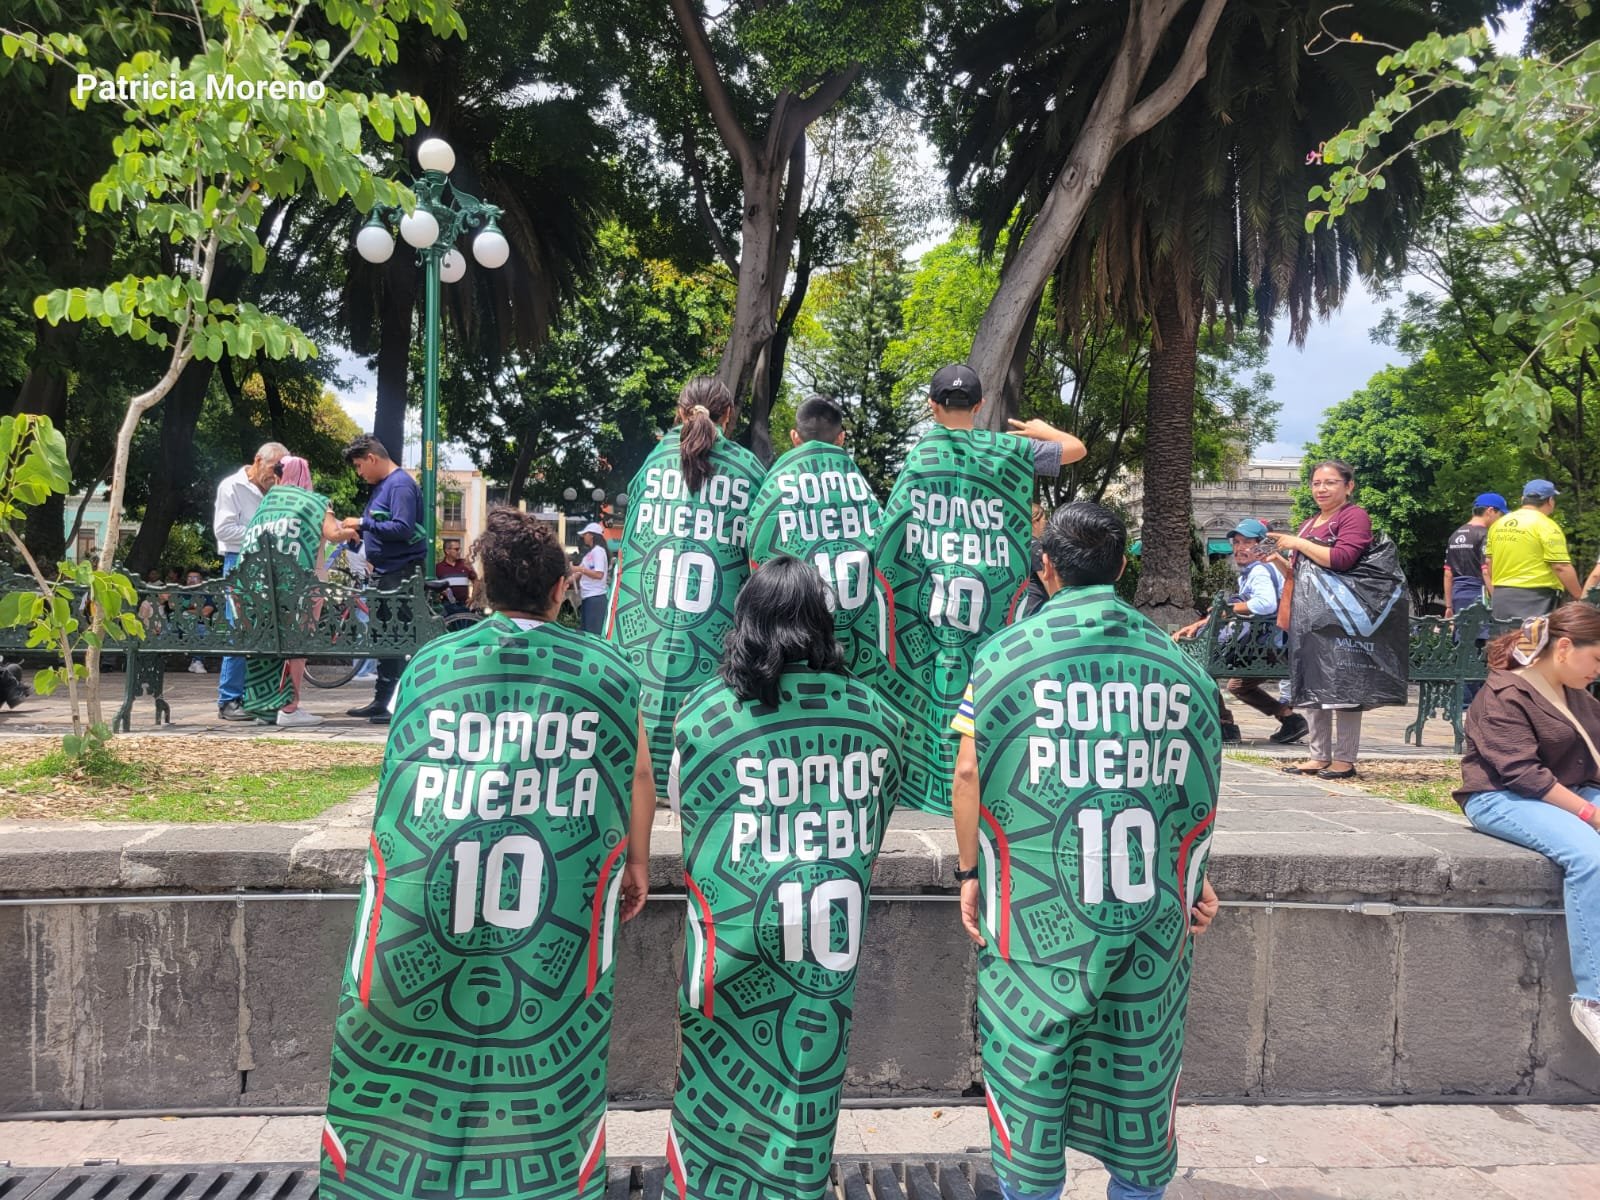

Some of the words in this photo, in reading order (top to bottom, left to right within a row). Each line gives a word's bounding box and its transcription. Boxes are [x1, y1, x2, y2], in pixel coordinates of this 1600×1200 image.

[636, 503, 748, 548] PUEBLA
[778, 505, 885, 542] PUEBL
[910, 489, 1004, 530] SOMOS
[906, 523, 1010, 567] PUEBLA
[655, 548, 715, 613] 10
[814, 551, 870, 613] 10
[929, 573, 985, 634] 10
[1033, 680, 1191, 732] SOMOS
[428, 709, 599, 763] SOMOS
[1028, 735, 1191, 789] PUEBLA
[414, 766, 599, 820] PUEBLA
[731, 807, 873, 862] PUEBL
[1077, 807, 1156, 905] 10
[454, 835, 545, 934] 10
[777, 879, 863, 972] 10
